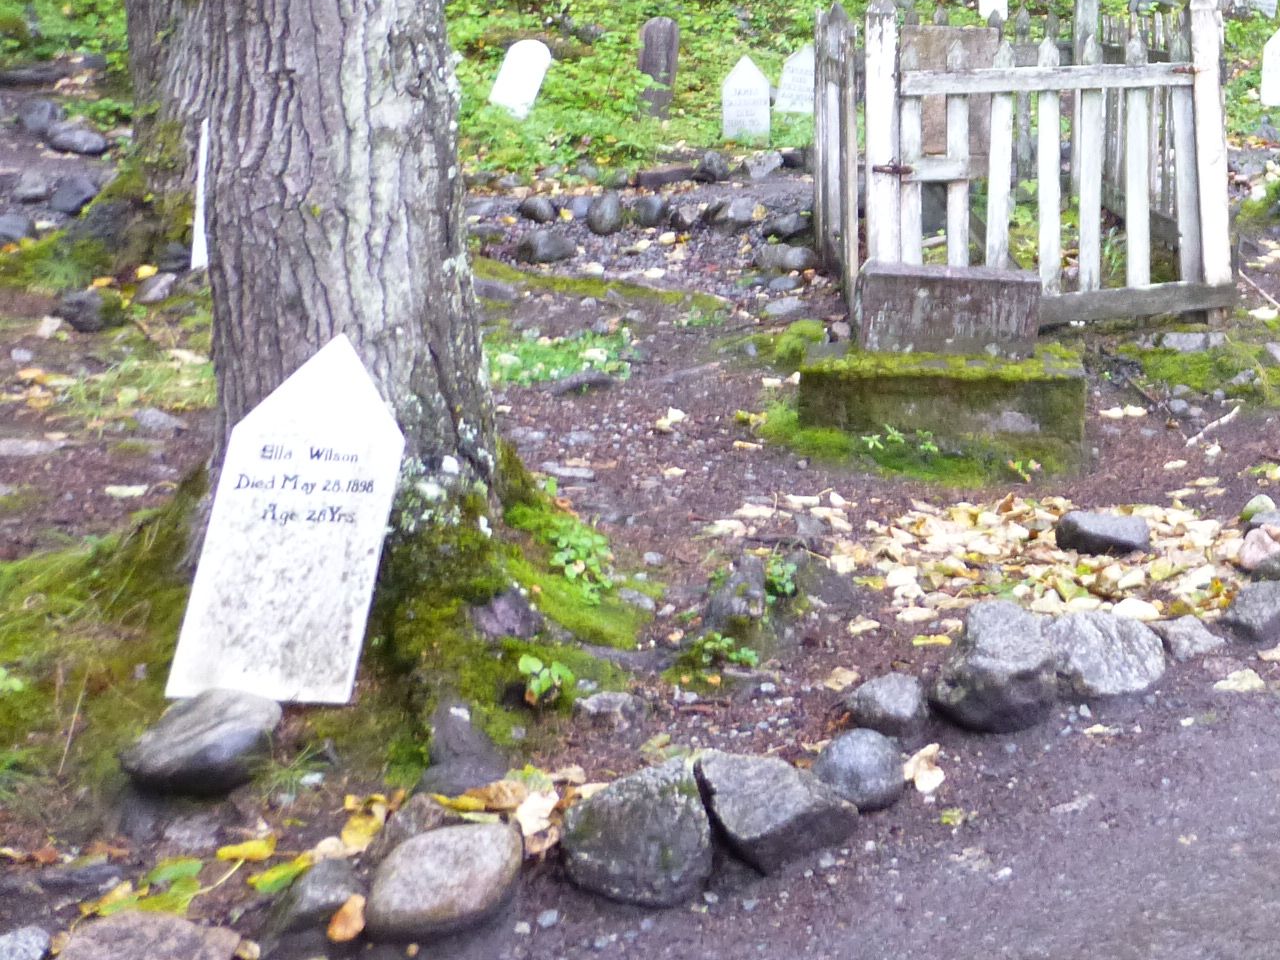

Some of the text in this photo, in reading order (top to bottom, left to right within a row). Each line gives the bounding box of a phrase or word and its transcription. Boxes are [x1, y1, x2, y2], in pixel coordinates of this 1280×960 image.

[259, 443, 360, 463] Ella Wilson
[233, 473, 276, 490] Died
[280, 473, 317, 495] May
[261, 503, 300, 527] Age
